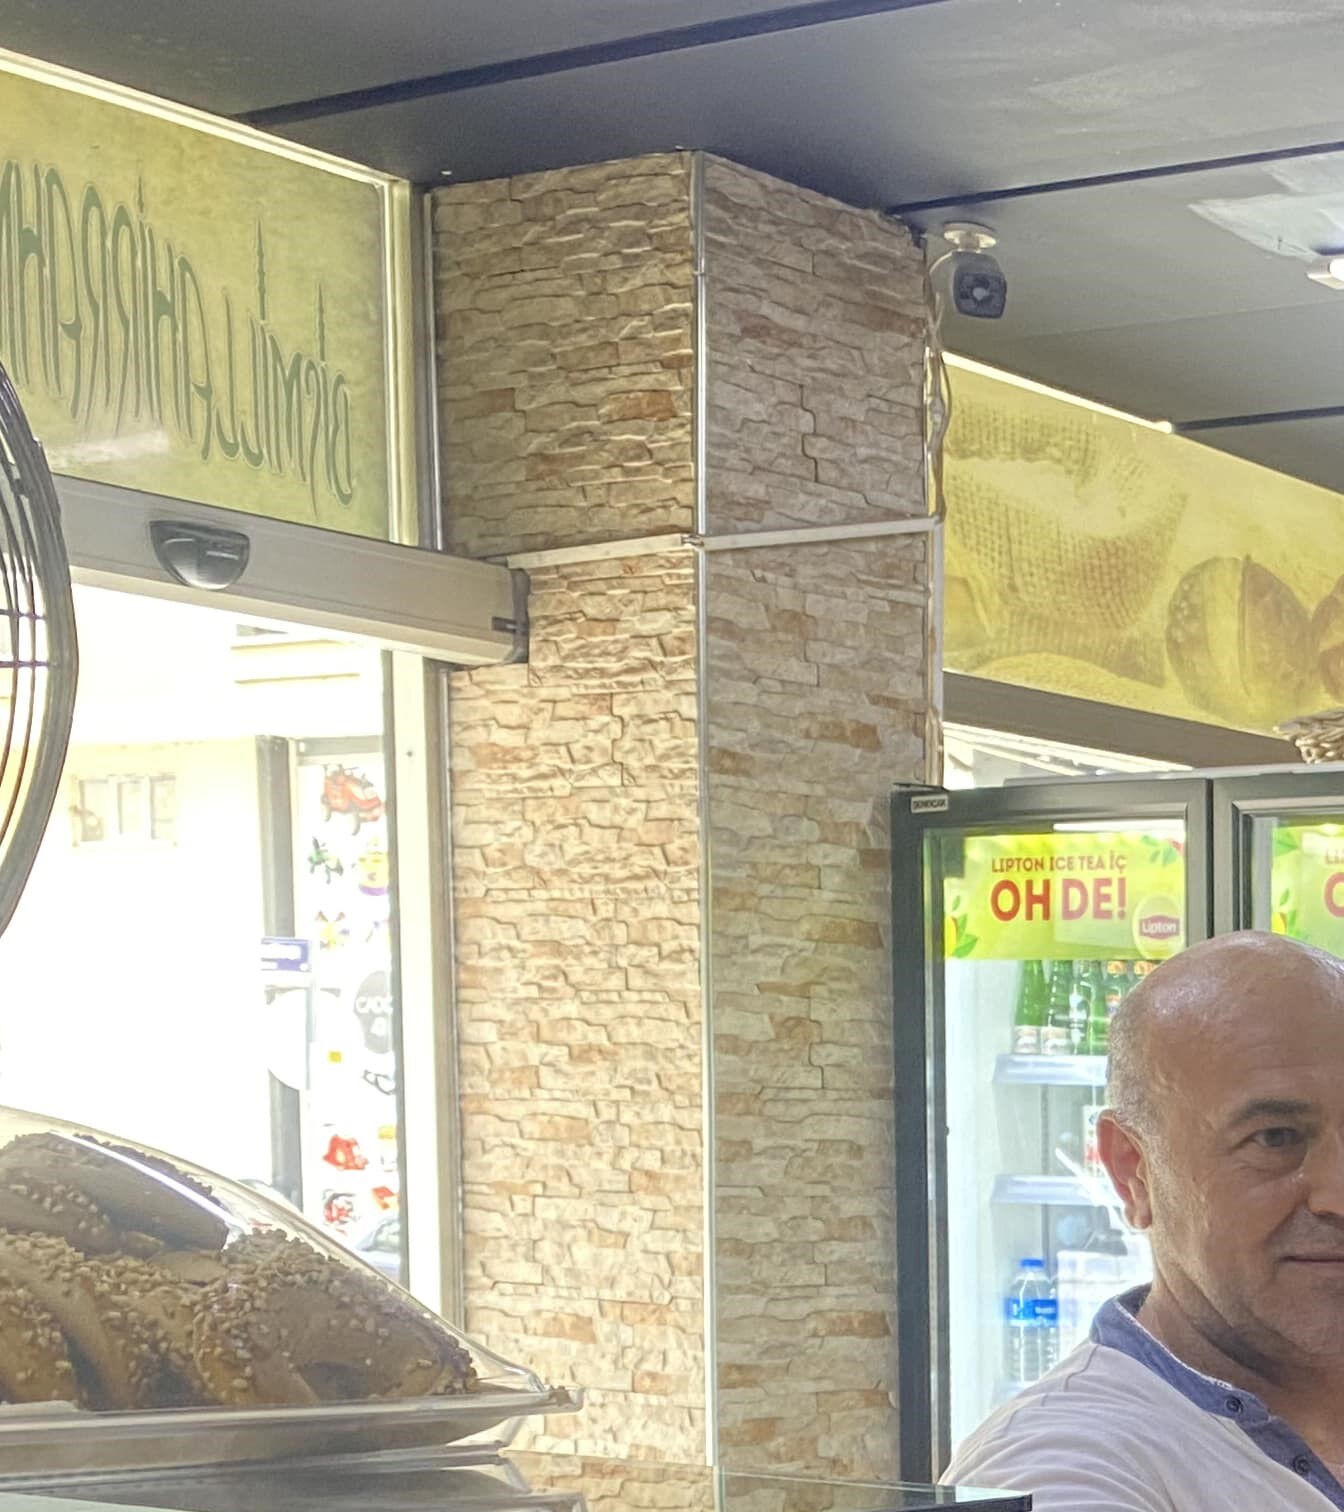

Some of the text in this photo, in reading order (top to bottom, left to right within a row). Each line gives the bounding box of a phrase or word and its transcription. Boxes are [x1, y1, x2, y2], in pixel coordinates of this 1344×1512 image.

[991, 850, 1126, 874] LIPTON ICE TEA İÇ
[990, 877, 1127, 921] OH DE!
[1142, 920, 1177, 935] Lipton
